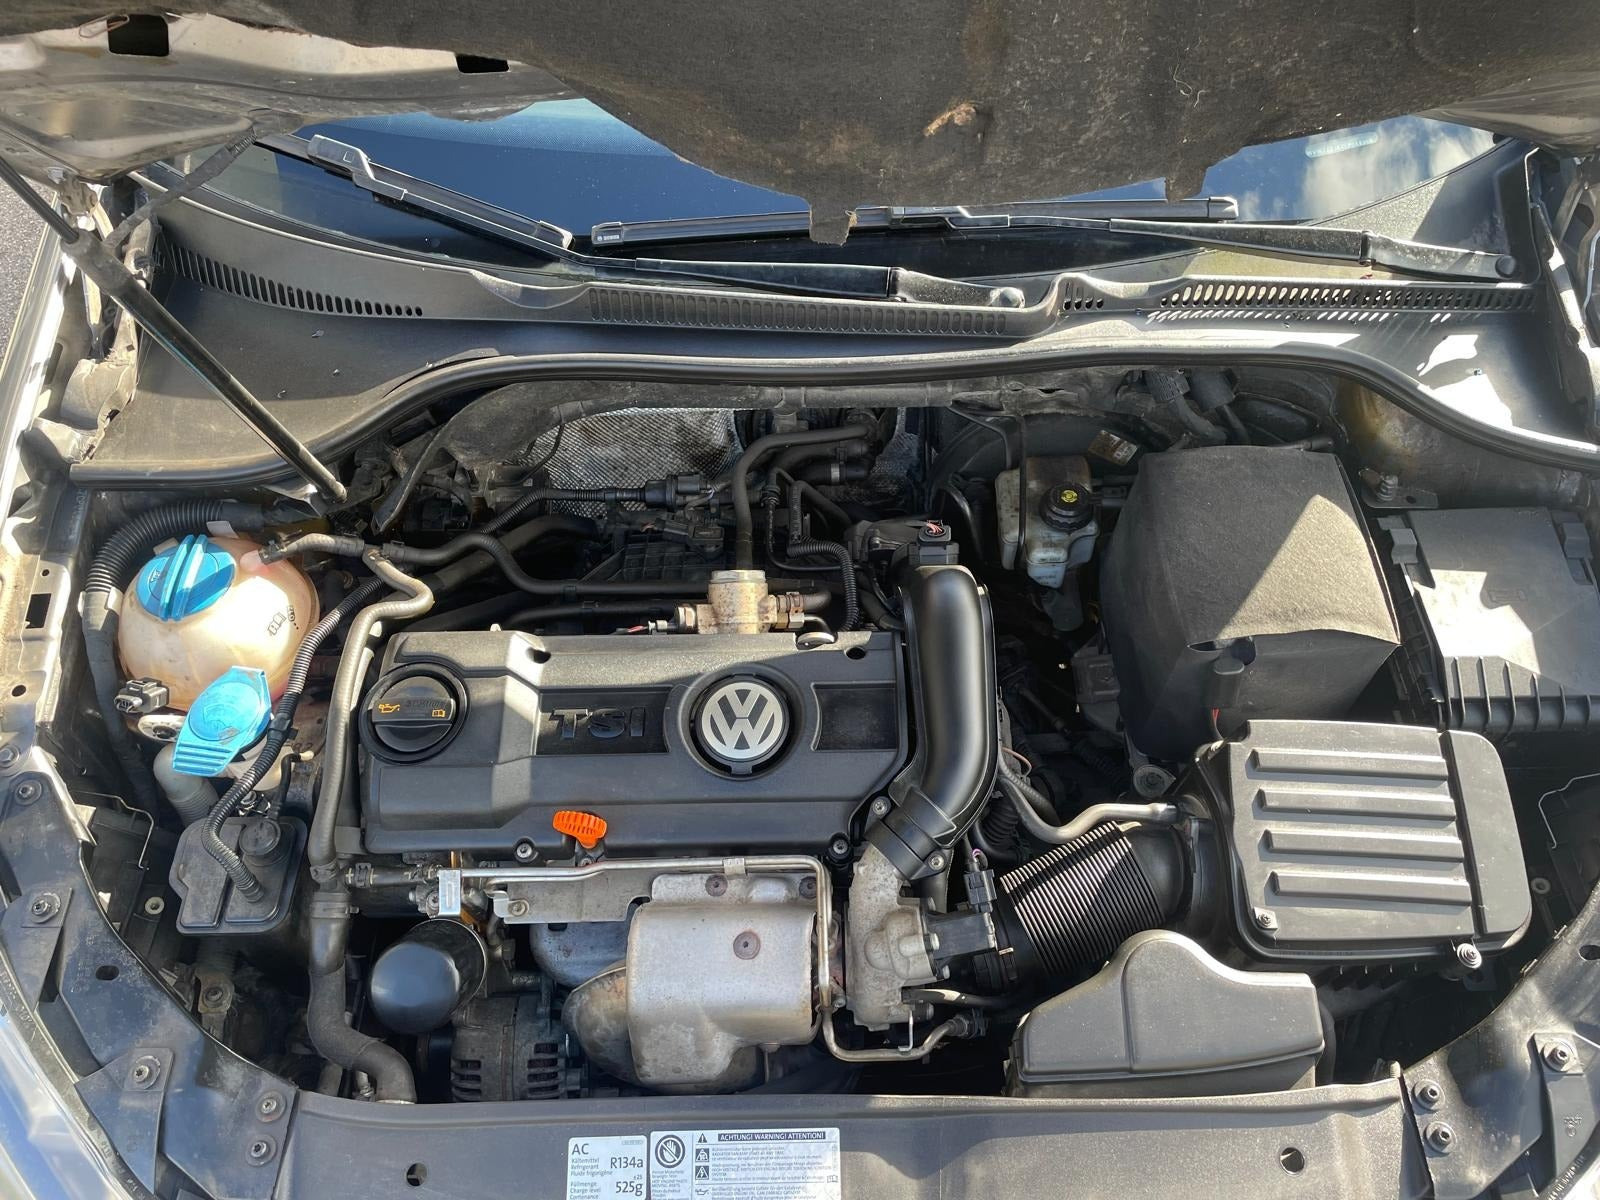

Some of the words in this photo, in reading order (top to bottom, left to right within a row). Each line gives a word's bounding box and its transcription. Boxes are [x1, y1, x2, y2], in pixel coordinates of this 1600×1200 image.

[551, 707, 646, 740] TSI
[720, 1133, 753, 1141] ACHTUNG!
[571, 1143, 589, 1155] AC
[610, 1156, 644, 1169] R134a
[615, 1180, 643, 1197] 525g
